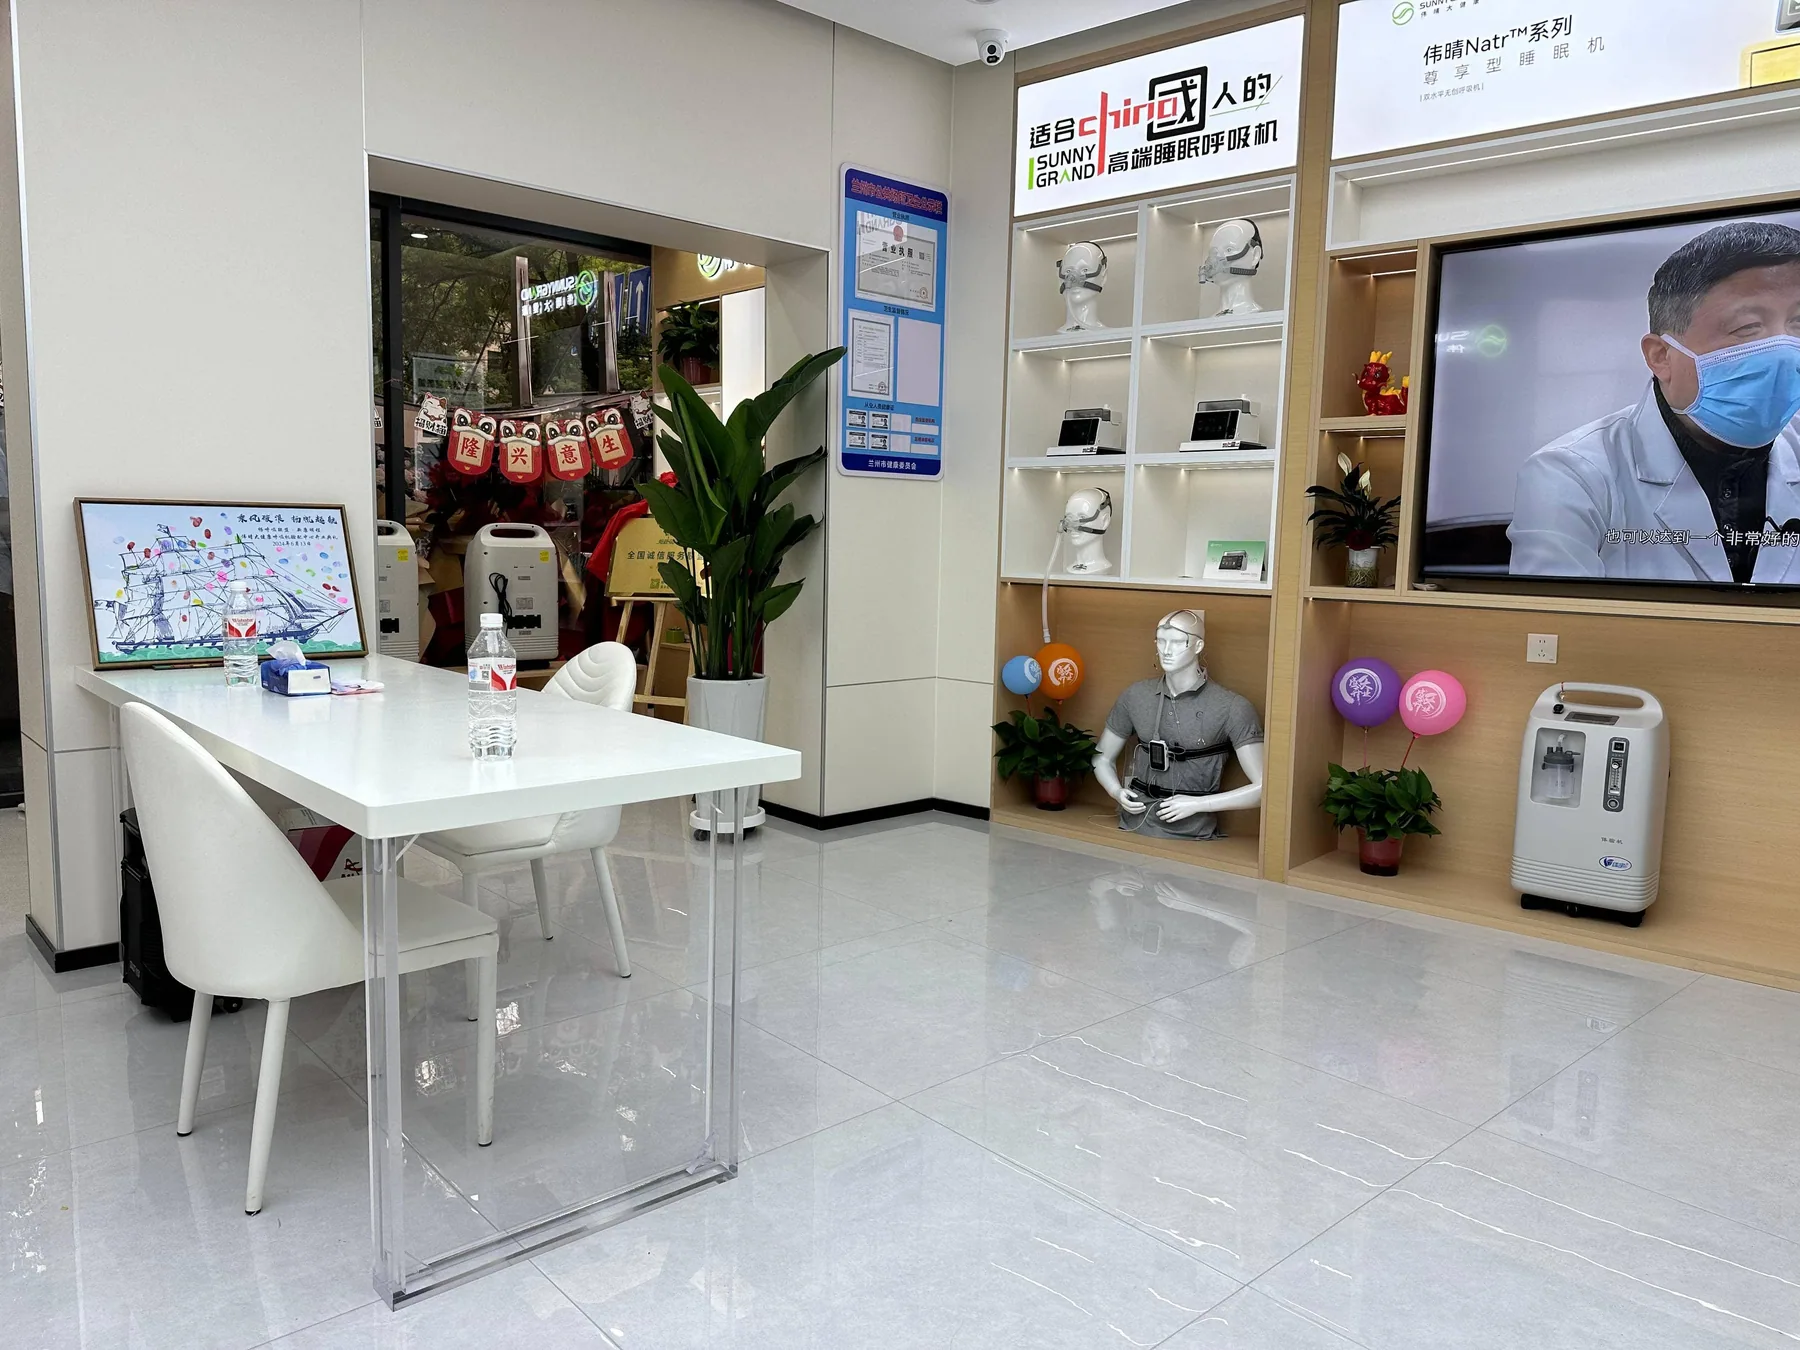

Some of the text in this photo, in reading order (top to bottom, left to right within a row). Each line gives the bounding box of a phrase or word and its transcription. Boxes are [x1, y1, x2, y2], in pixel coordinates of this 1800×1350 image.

[1423, 36, 1606, 86] 尊享型睡眠机
[1029, 117, 1076, 149] 适合
[1107, 119, 1279, 175] 高端睡眠呼吸机
[1037, 143, 1096, 170] SUNNY
[1036, 163, 1096, 188] GRAND
[461, 435, 620, 465] 隆 兴 意 生
[868, 459, 917, 471] 兰州市健康委员会
[1605, 529, 1800, 547] 也可以达到一个非常好的
